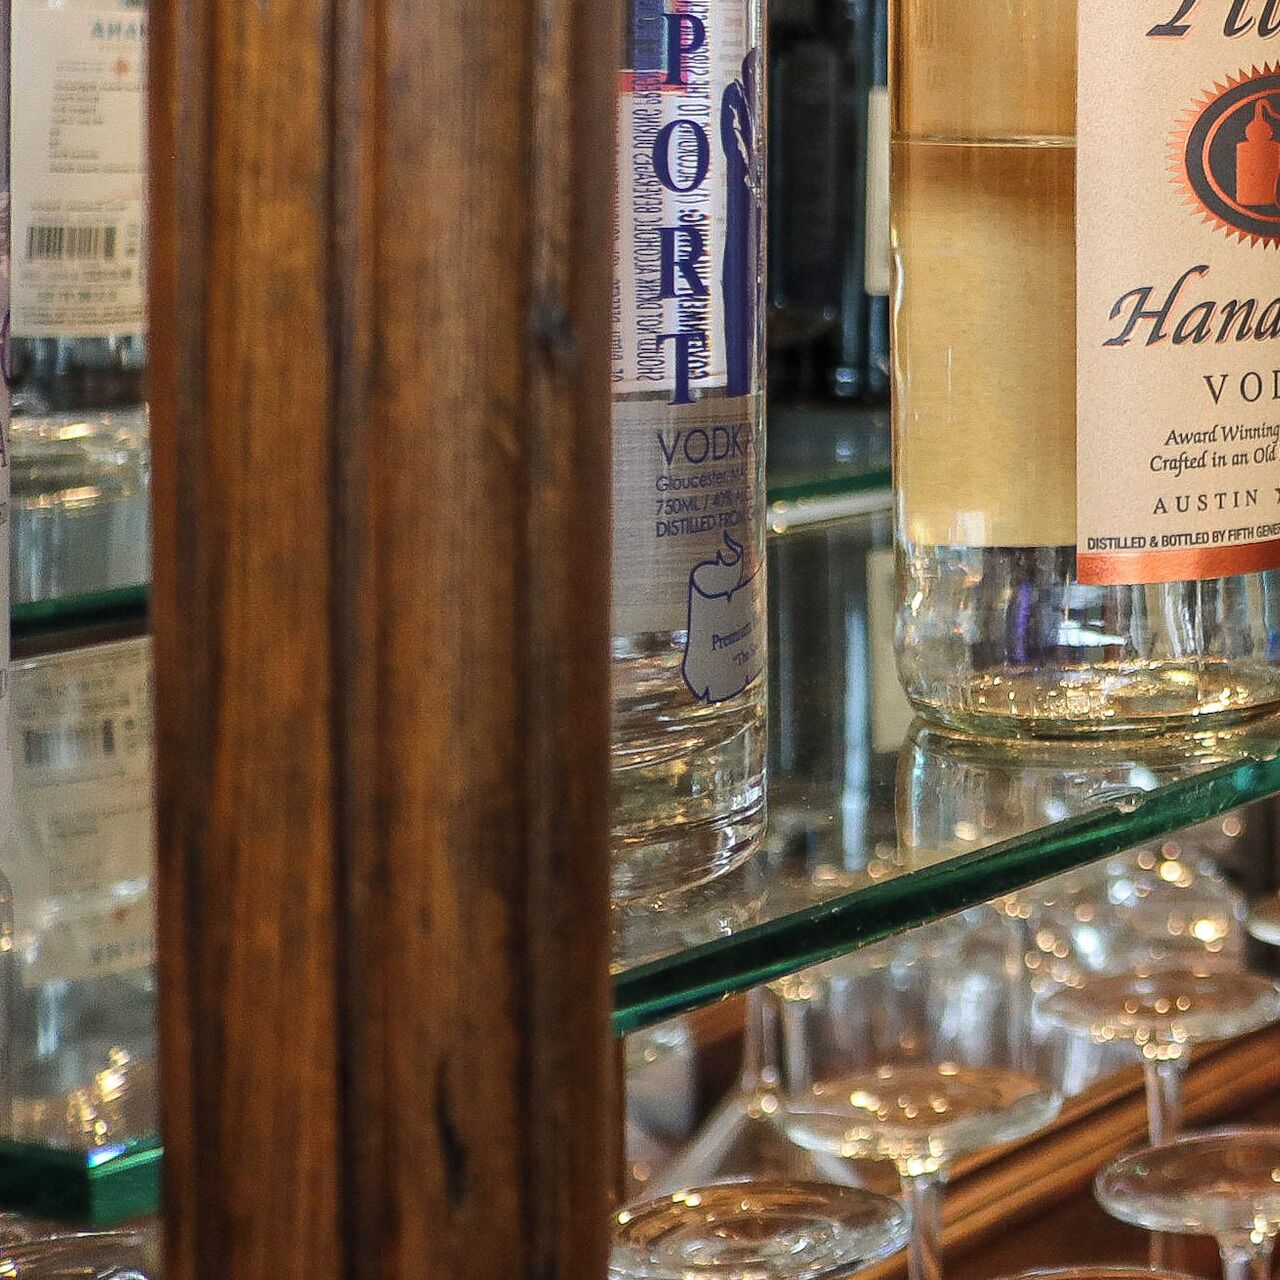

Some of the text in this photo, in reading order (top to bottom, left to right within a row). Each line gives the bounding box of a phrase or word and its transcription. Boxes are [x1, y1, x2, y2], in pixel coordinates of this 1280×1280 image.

[1164, 424, 1218, 446] Award
[1221, 422, 1280, 444] Winning
[1150, 453, 1206, 478] Crafted
[1212, 451, 1228, 467] in
[1232, 452, 1249, 466] an
[1254, 444, 1276, 464] Old
[1153, 488, 1259, 516] AUSTIN
[1087, 534, 1146, 551] DISTILLED
[1149, 535, 1159, 549] &
[1161, 531, 1210, 548] BOTTLED
[1212, 529, 1226, 544] BY
[1227, 526, 1254, 541] FIFTH
